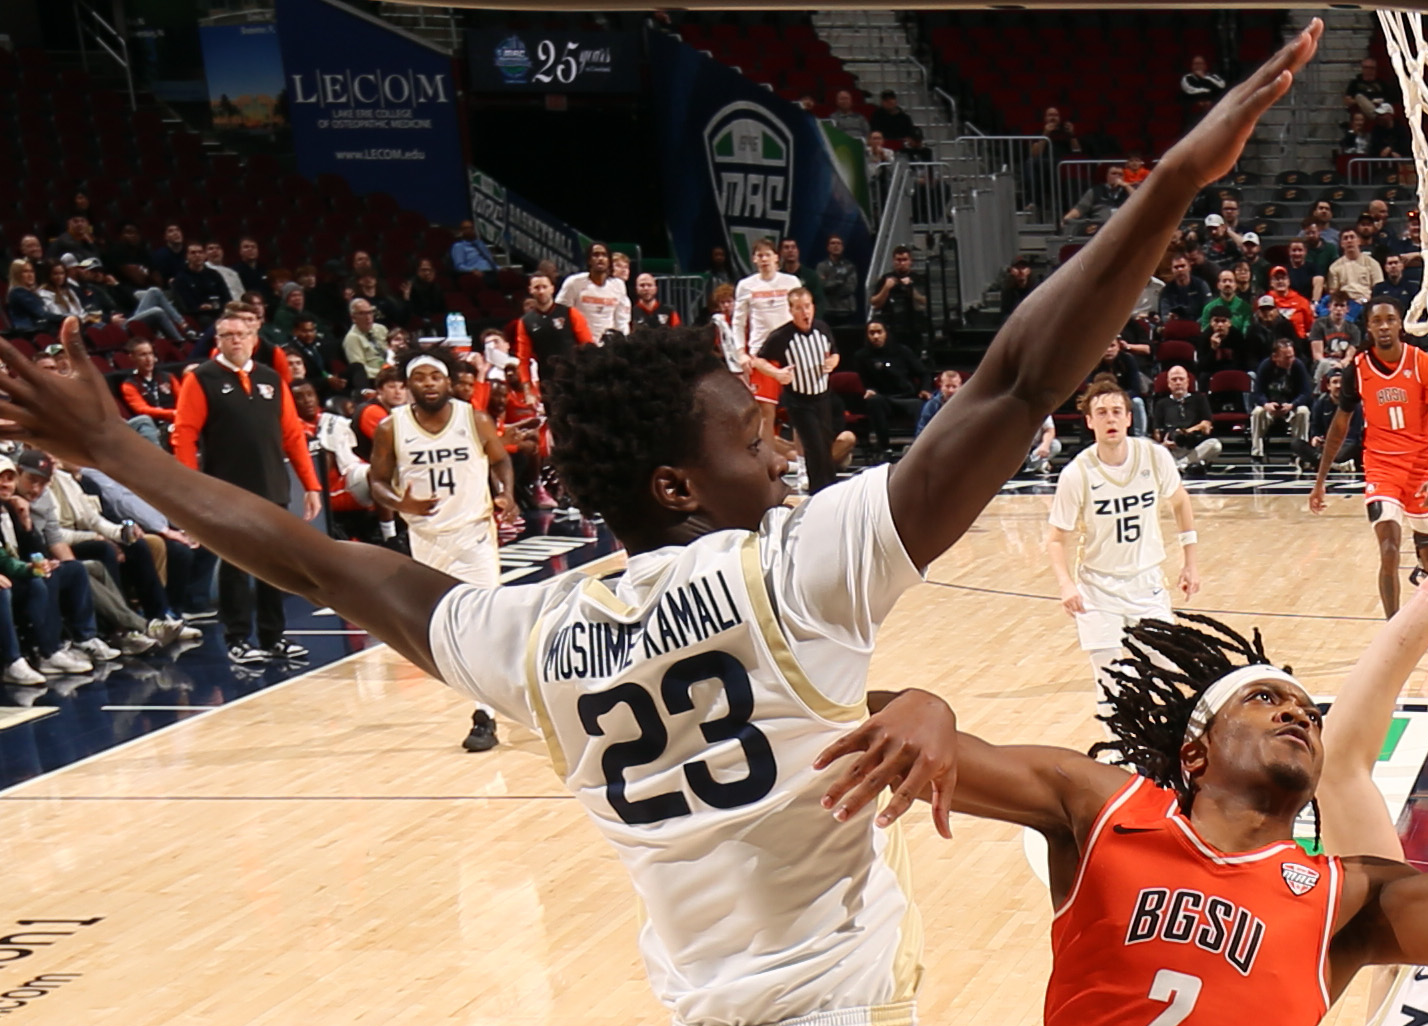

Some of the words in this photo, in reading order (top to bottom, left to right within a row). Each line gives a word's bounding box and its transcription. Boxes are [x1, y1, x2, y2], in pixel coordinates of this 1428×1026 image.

[531, 39, 580, 83] 25
[317, 119, 330, 129] OF
[391, 119, 432, 129] MEDICINE
[332, 109, 354, 119] LAKE
[375, 109, 413, 119] COLLEGE
[334, 148, 426, 160] www.LECOM.edu
[720, 172, 791, 222] MAC
[508, 203, 574, 261] BASKETBALL
[1376, 386, 1409, 406] BGSU
[1388, 405, 1406, 431] 11
[408, 447, 470, 465] ZIPS
[428, 467, 456, 496] 14
[1093, 490, 1155, 515] ZIPS
[1116, 515, 1141, 544] 15
[576, 649, 778, 826] 23
[1124, 886, 1268, 977] BGSU
